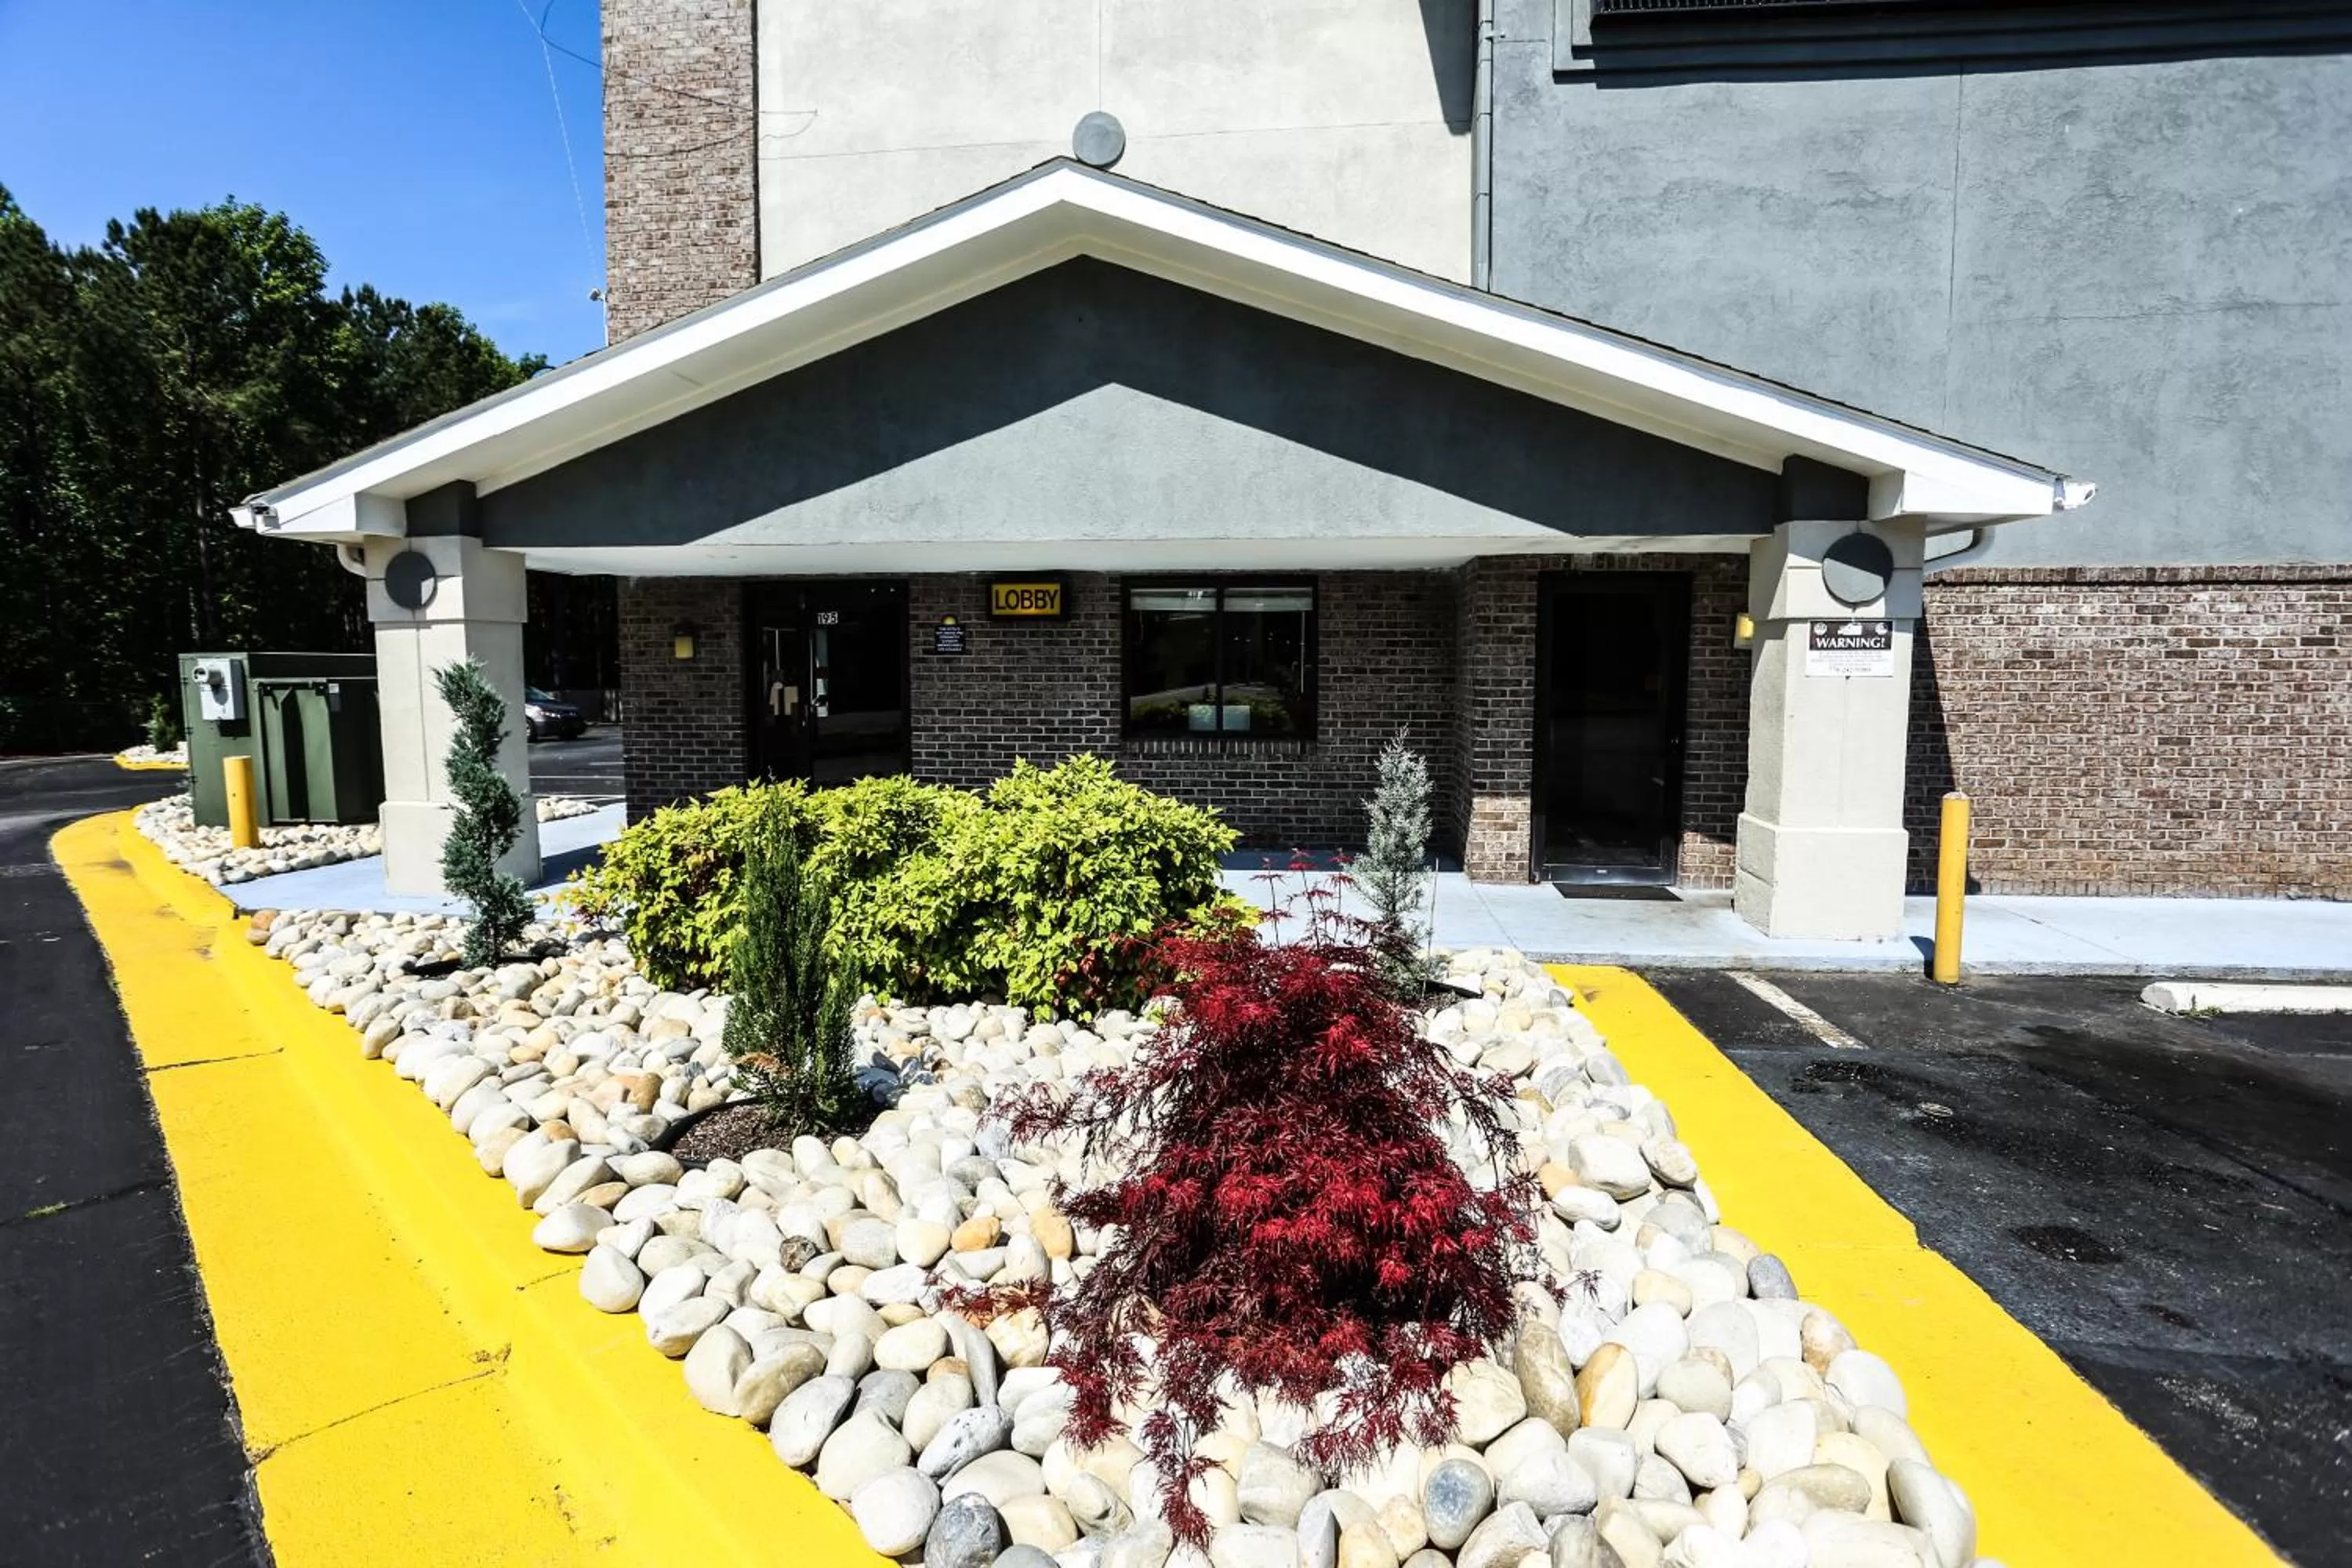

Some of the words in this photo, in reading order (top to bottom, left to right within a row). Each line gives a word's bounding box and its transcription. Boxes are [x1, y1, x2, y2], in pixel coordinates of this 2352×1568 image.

[995, 589, 1058, 610] LOBBY
[817, 612, 838, 625] 195
[1816, 637, 1886, 648] WARNING!
